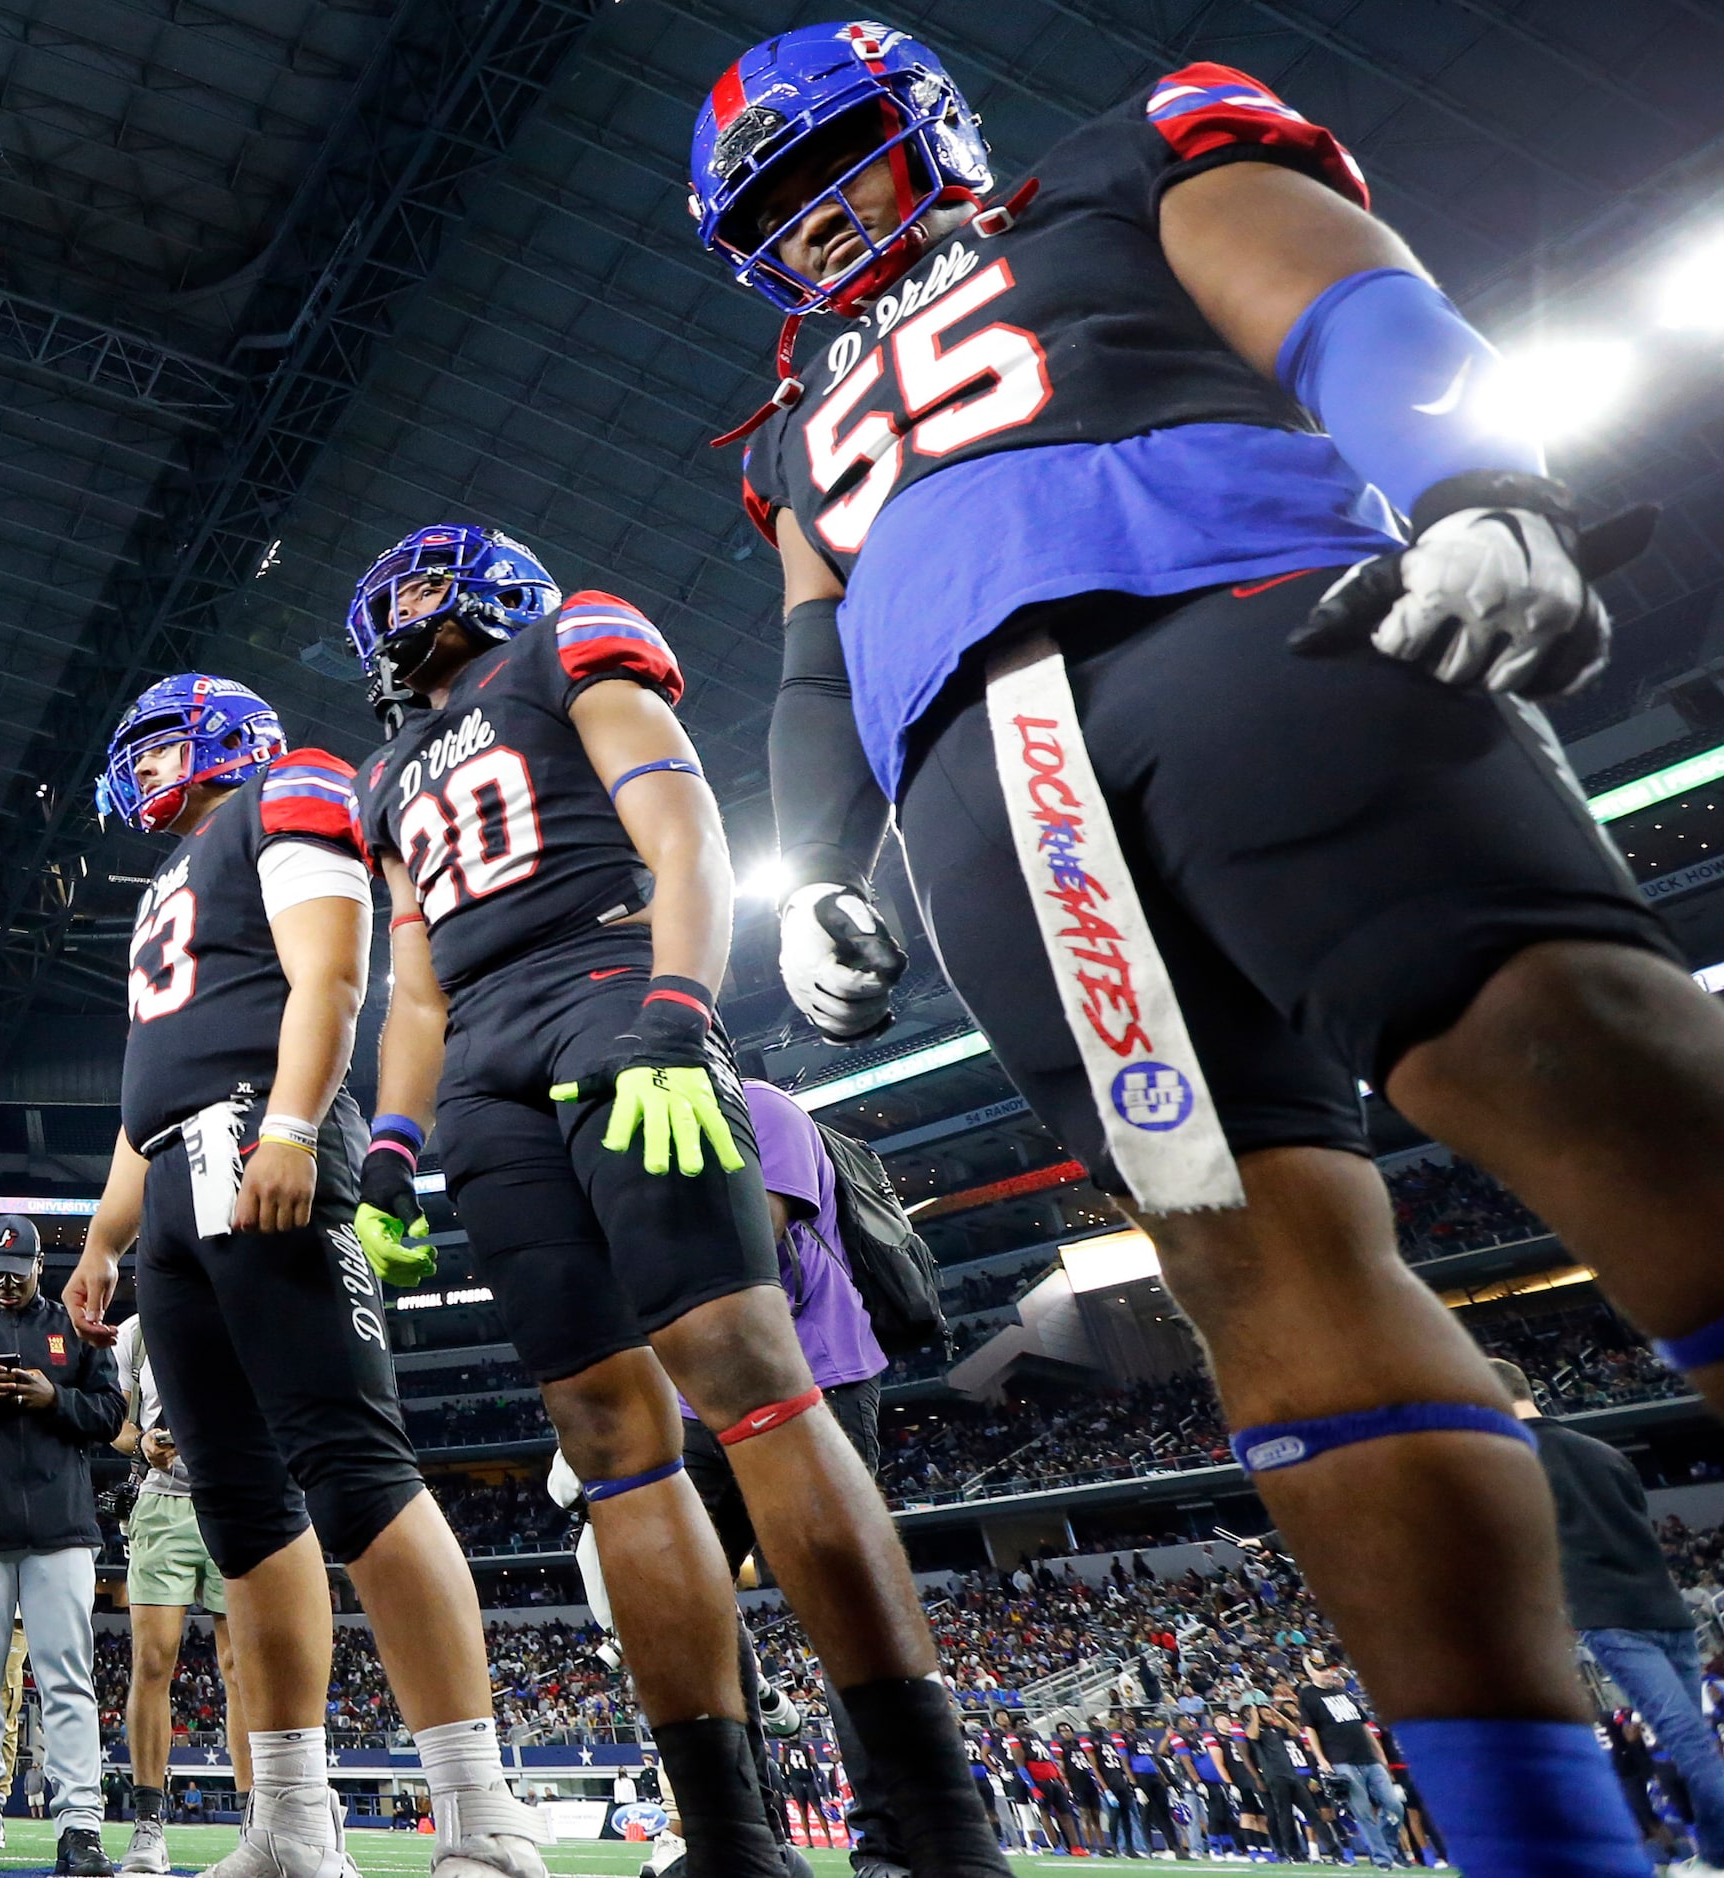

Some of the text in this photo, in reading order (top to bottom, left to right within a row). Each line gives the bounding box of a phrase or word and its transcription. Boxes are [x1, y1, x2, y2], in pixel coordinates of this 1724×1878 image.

[803, 256, 1054, 554] 55
[399, 707, 495, 810] D'Ville
[400, 745, 544, 926] 20
[1643, 876, 1683, 898] UCK
[236, 1082, 255, 1094] XL
[985, 1098, 1024, 1119] RANDY
[28, 1200, 92, 1213] UNIVERSITY
[396, 1292, 443, 1311] OFFICIAL
